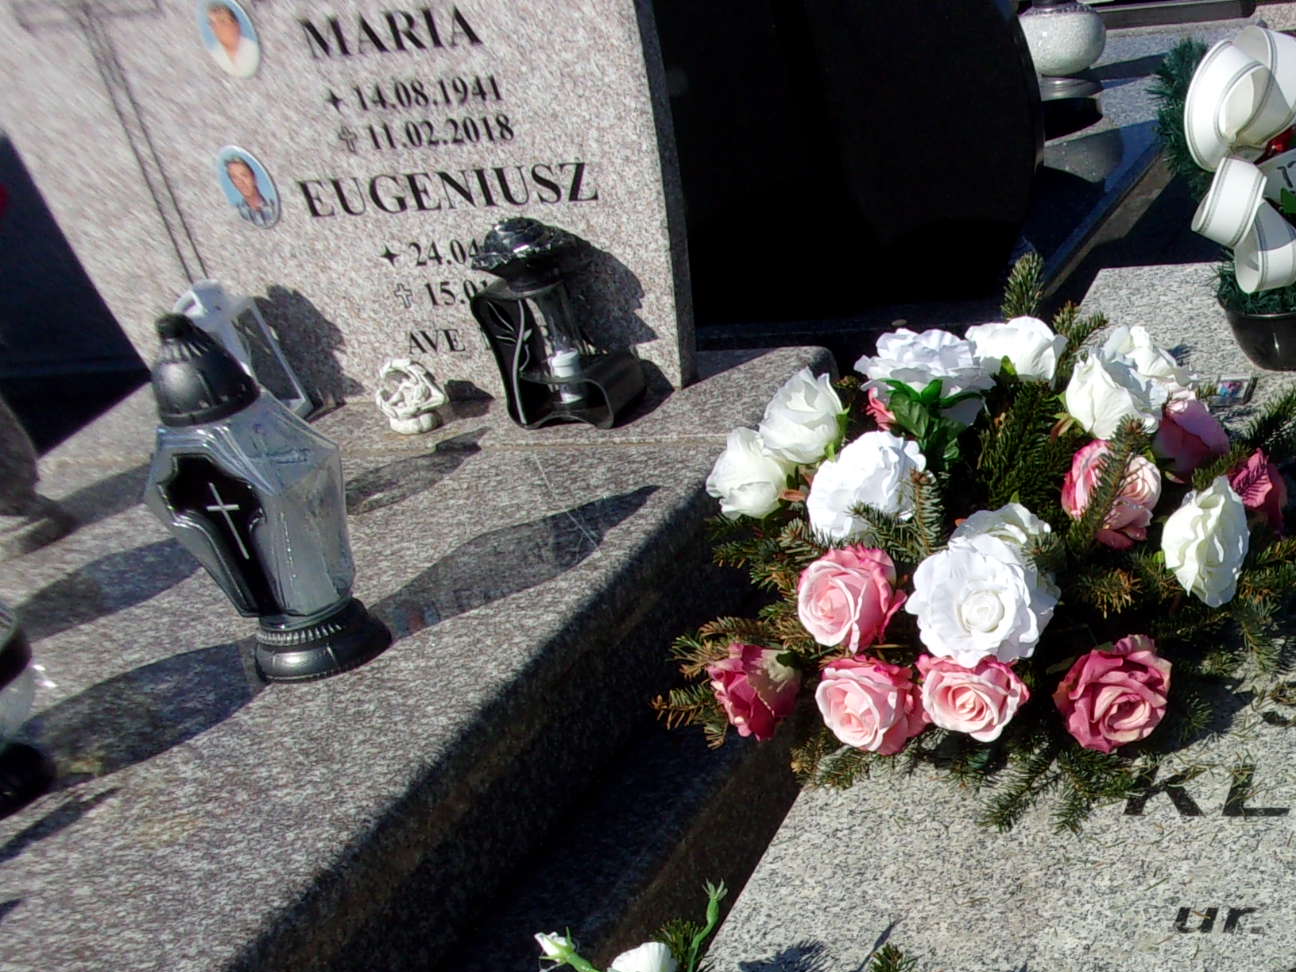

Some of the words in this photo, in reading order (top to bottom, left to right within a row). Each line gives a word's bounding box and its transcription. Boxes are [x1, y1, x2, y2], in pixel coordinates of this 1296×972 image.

[297, 5, 483, 59] MARIA
[352, 74, 502, 110] 14.08.1941
[367, 114, 515, 149] 11.02.2018
[297, 161, 599, 218] EUGENIUSZ
[406, 328, 466, 354] AVE
[1172, 905, 1265, 935] ur.
